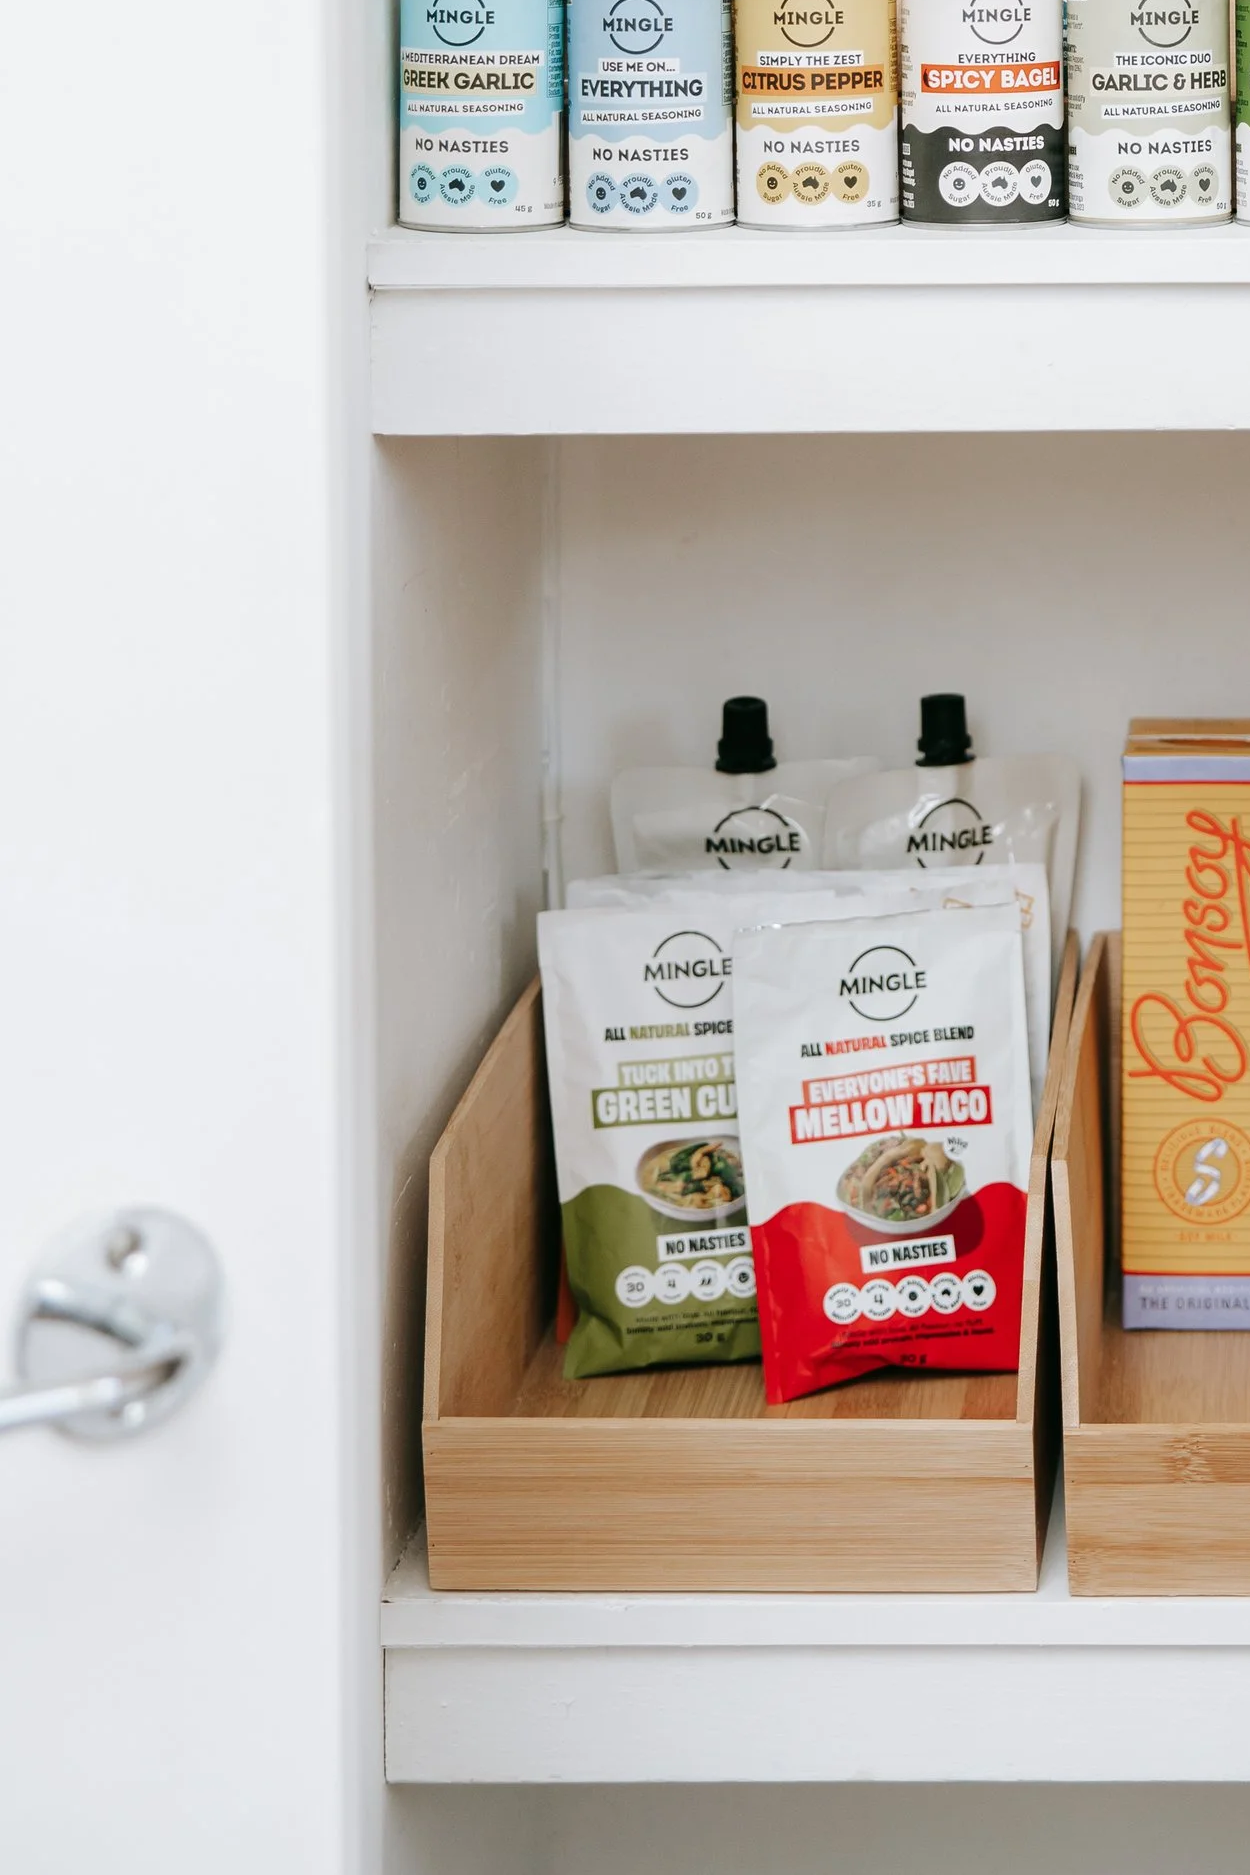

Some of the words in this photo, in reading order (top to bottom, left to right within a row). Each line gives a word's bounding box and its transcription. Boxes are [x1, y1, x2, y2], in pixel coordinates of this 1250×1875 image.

[427, 9, 495, 25] MINGLE
[774, 11, 844, 25] MINGLE
[963, 8, 1031, 22] MINGLE
[1130, 10, 1199, 25] MINGLE
[603, 18, 673, 32] MINGLE
[406, 53, 495, 65] MEDITERRANEAN
[500, 54, 540, 65] DREAM
[760, 56, 803, 65] SIMPLY
[806, 56, 829, 65] THE
[834, 54, 861, 64] ZEST
[958, 53, 1035, 63] EVERYTHING
[1116, 55, 1137, 65] THE
[1141, 55, 1187, 65] ICONIC
[1190, 53, 1211, 63] DUO
[602, 62, 624, 72] USE
[626, 62, 644, 71] ME
[647, 62, 675, 71] ON...
[404, 69, 450, 89] GREEK
[454, 73, 534, 90] GARLIC
[742, 73, 805, 90] CITRUS
[811, 71, 883, 89] PEPPER
[927, 69, 995, 88] SPICY
[1001, 68, 1057, 87] BAGEL
[1092, 74, 1168, 91] GARLIC
[1173, 74, 1186, 89] &
[1191, 70, 1226, 88] HERB
[581, 79, 703, 97] EVERYTHING
[420, 104, 459, 113] NATURAL
[463, 104, 524, 112] SEASONING
[752, 106, 765, 114] ALL
[767, 104, 811, 114] NATURAL
[815, 102, 871, 113] SEASONING
[935, 104, 951, 113] ALL
[955, 103, 1001, 112] NATURAL
[1004, 99, 1053, 110] SEASONING
[1104, 107, 1119, 116] ALL
[1123, 105, 1169, 115] NATURAL
[1172, 101, 1221, 113] SEASONING
[583, 112, 595, 122] ALL
[596, 112, 639, 122] NATURAL
[642, 110, 701, 120] SEASONING
[416, 139, 433, 151] NO
[439, 140, 509, 152] NASTIES
[763, 141, 784, 153] NO
[791, 140, 860, 153] NASTIES
[949, 138, 975, 151] NO
[979, 136, 1044, 151] NASTIES
[1118, 142, 1142, 154] NO
[1148, 140, 1212, 154] NASTIES
[593, 148, 612, 160] NO
[618, 149, 689, 161] NASTIES
[984, 165, 1015, 176] Proudly
[982, 182, 1002, 203] Aussie
[1004, 182, 1018, 202] Made
[705, 833, 801, 854] MINGLE
[907, 826, 993, 853] MINGLE
[644, 958, 732, 981] MINGLE
[840, 971, 927, 996] MINGLE
[605, 1027, 625, 1041] ALL
[630, 1024, 690, 1040] NATURAL
[694, 1020, 733, 1036] SPICE
[801, 1044, 822, 1057] ALL
[825, 1036, 887, 1054] NATURAL
[890, 1032, 930, 1046] SPICE
[934, 1026, 974, 1041] BLEND
[622, 1063, 670, 1086] TUCK
[675, 1059, 716, 1081] INTO
[810, 1066, 925, 1103] EVERYONE'S
[928, 1060, 971, 1084] FAVE
[597, 1087, 691, 1124] GREEN
[796, 1094, 913, 1139] MELLOW
[918, 1090, 987, 1123] TACO
[666, 1240, 685, 1255] NO
[689, 1233, 745, 1252] NASTIES
[869, 1249, 888, 1265] NO
[892, 1242, 948, 1261] NASTIES
[836, 1299, 851, 1308] 30
[874, 1294, 883, 1304] 4
[1139, 1297, 1167, 1310] THE
[1177, 1297, 1250, 1310] ORIGINAL
